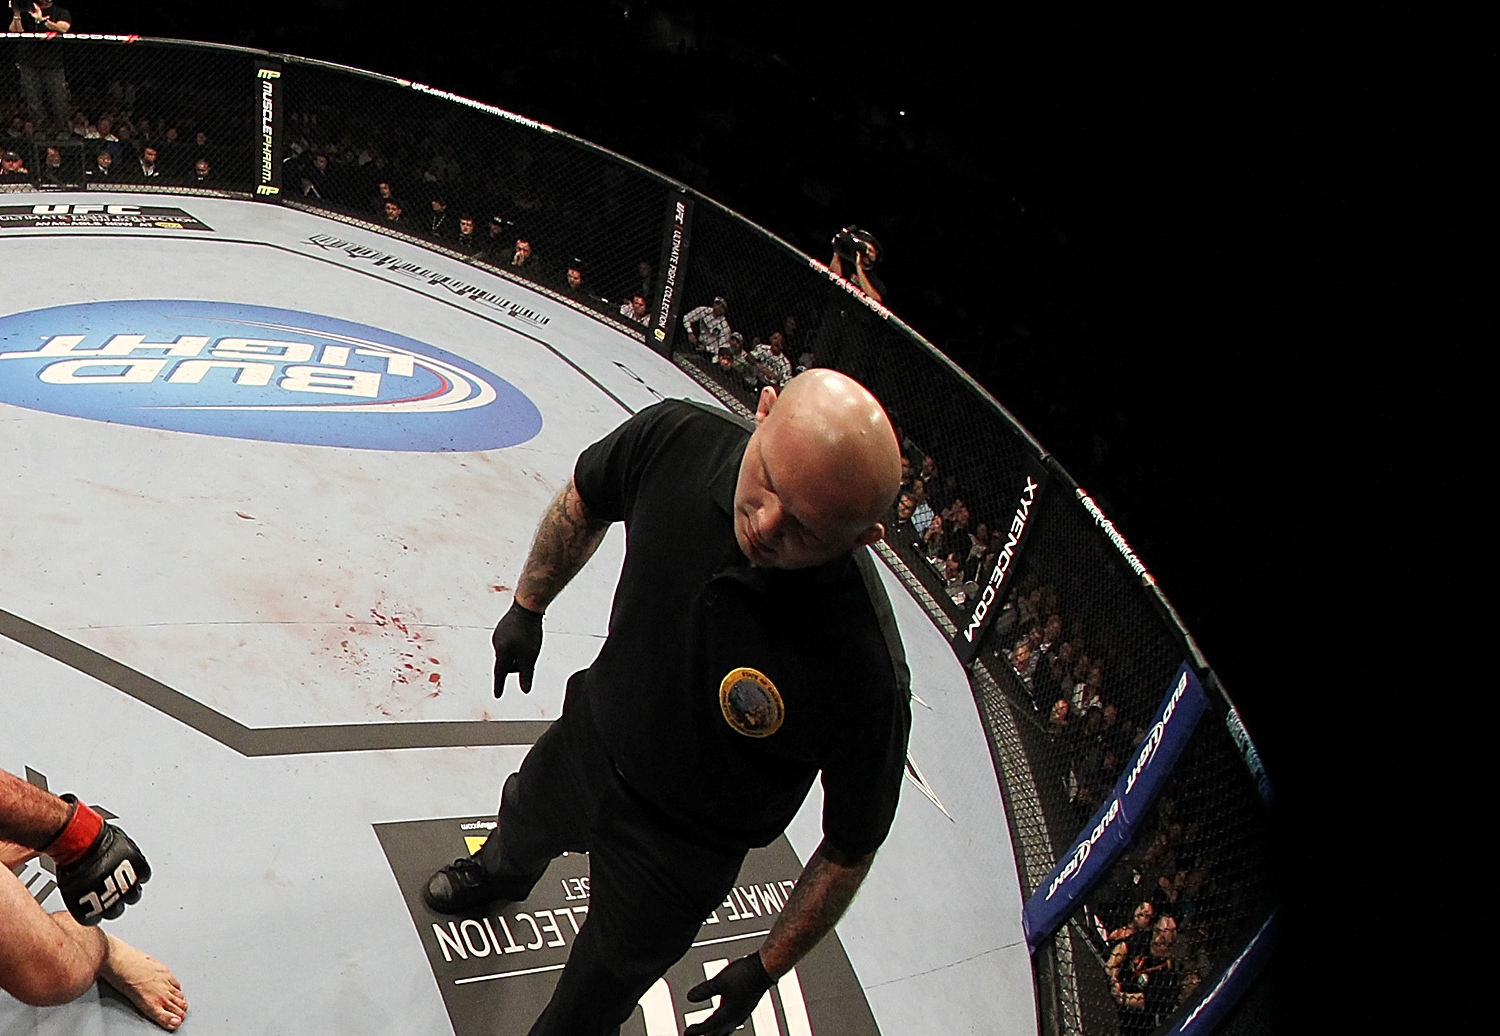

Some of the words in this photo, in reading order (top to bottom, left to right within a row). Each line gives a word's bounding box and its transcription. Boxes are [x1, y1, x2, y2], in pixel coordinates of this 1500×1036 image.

[32, 203, 142, 215] UFC
[37, 358, 382, 399] BUD
[963, 476, 1038, 642] XYIENCE.COM
[1162, 671, 1189, 724] BUD
[1125, 721, 1165, 795] LIGHT
[1090, 799, 1119, 845] BUD
[78, 858, 138, 919] UFC
[1045, 839, 1092, 901] LIGHT
